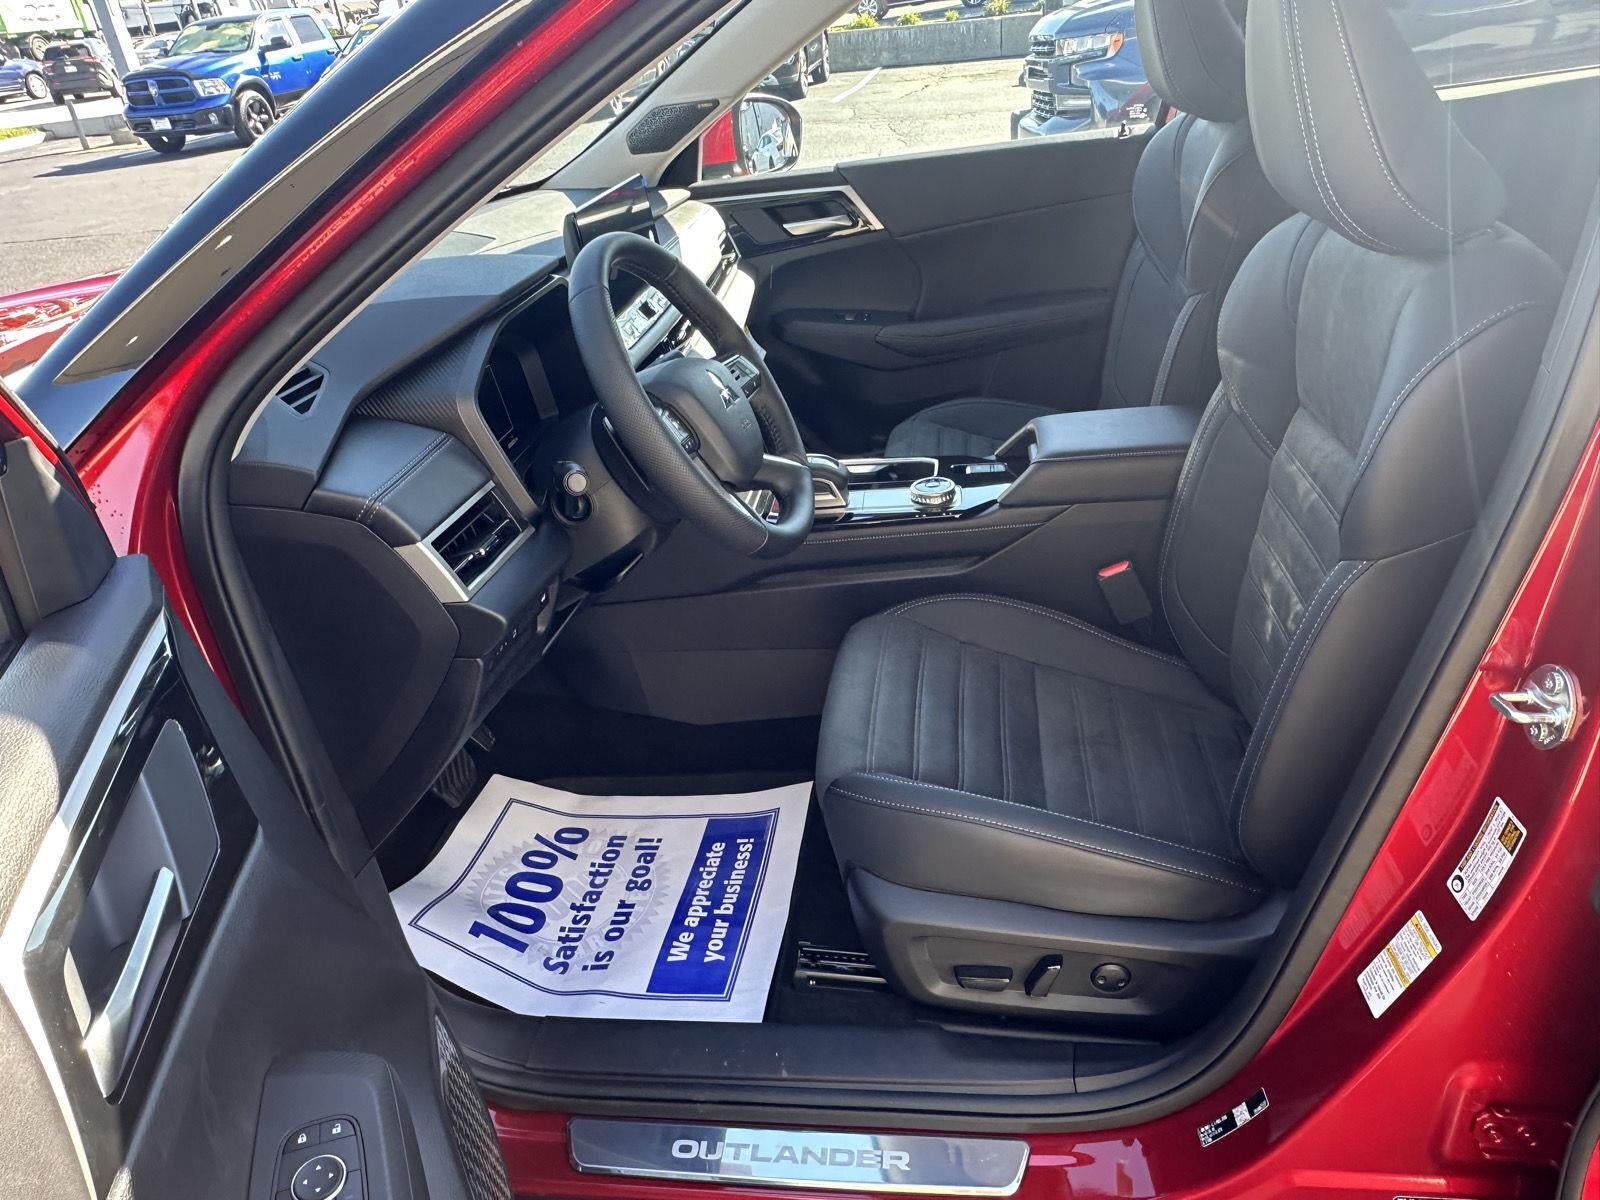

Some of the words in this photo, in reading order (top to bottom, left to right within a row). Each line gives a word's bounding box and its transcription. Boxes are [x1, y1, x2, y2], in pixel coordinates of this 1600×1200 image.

[468, 827, 590, 953] 100%
[543, 835, 628, 975] Satisfaction
[581, 950, 615, 972] is
[604, 899, 637, 942] our
[625, 837, 663, 892] goal!
[666, 931, 695, 962] We
[684, 842, 726, 928] appreciate
[713, 837, 755, 915] business!
[703, 918, 730, 963] your
[671, 1139, 911, 1171] OUTLANDER
